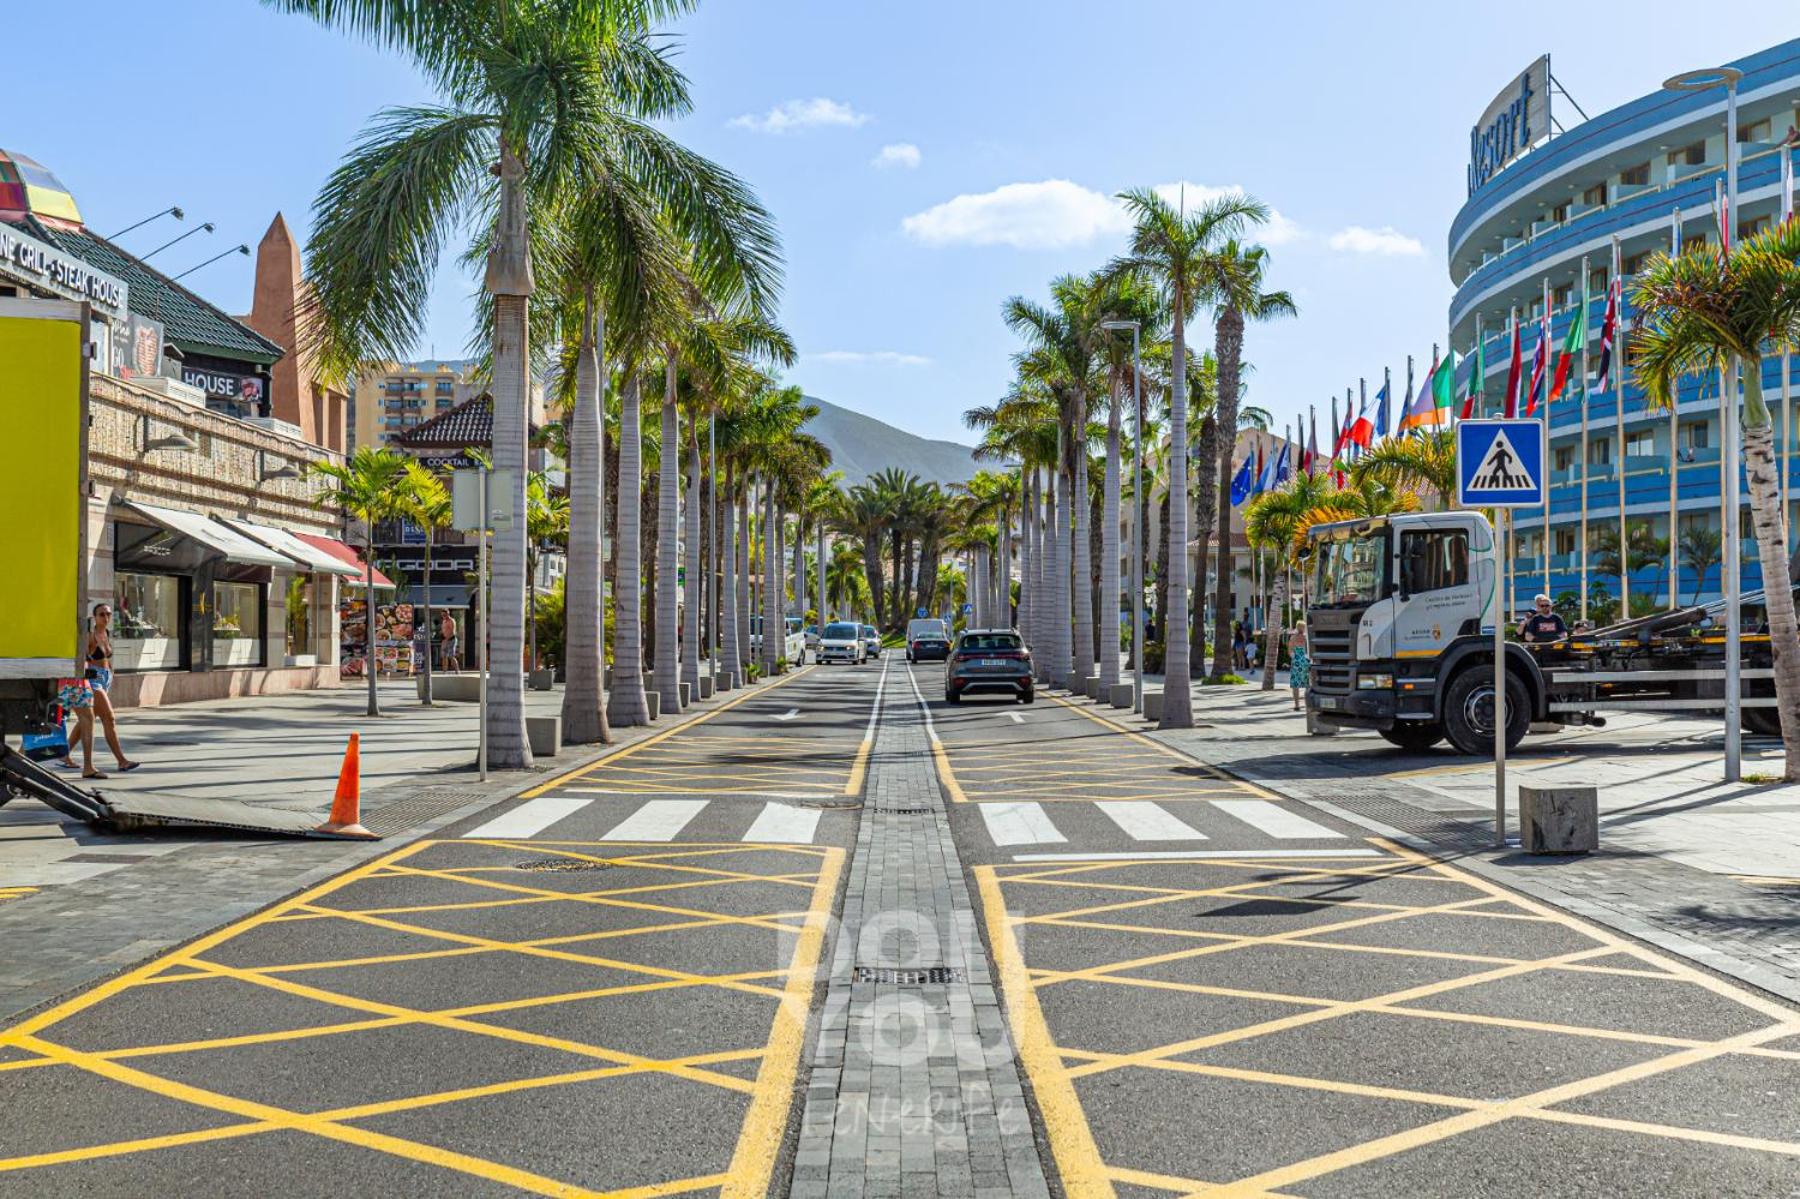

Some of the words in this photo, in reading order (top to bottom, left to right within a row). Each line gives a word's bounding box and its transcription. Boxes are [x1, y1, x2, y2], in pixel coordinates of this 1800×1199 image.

[20, 243, 48, 276] GRILL
[57, 259, 89, 295] STEAK
[92, 277, 123, 310] HOUSE
[185, 371, 234, 396] HOUSE
[427, 458, 469, 466] COCKTAIL
